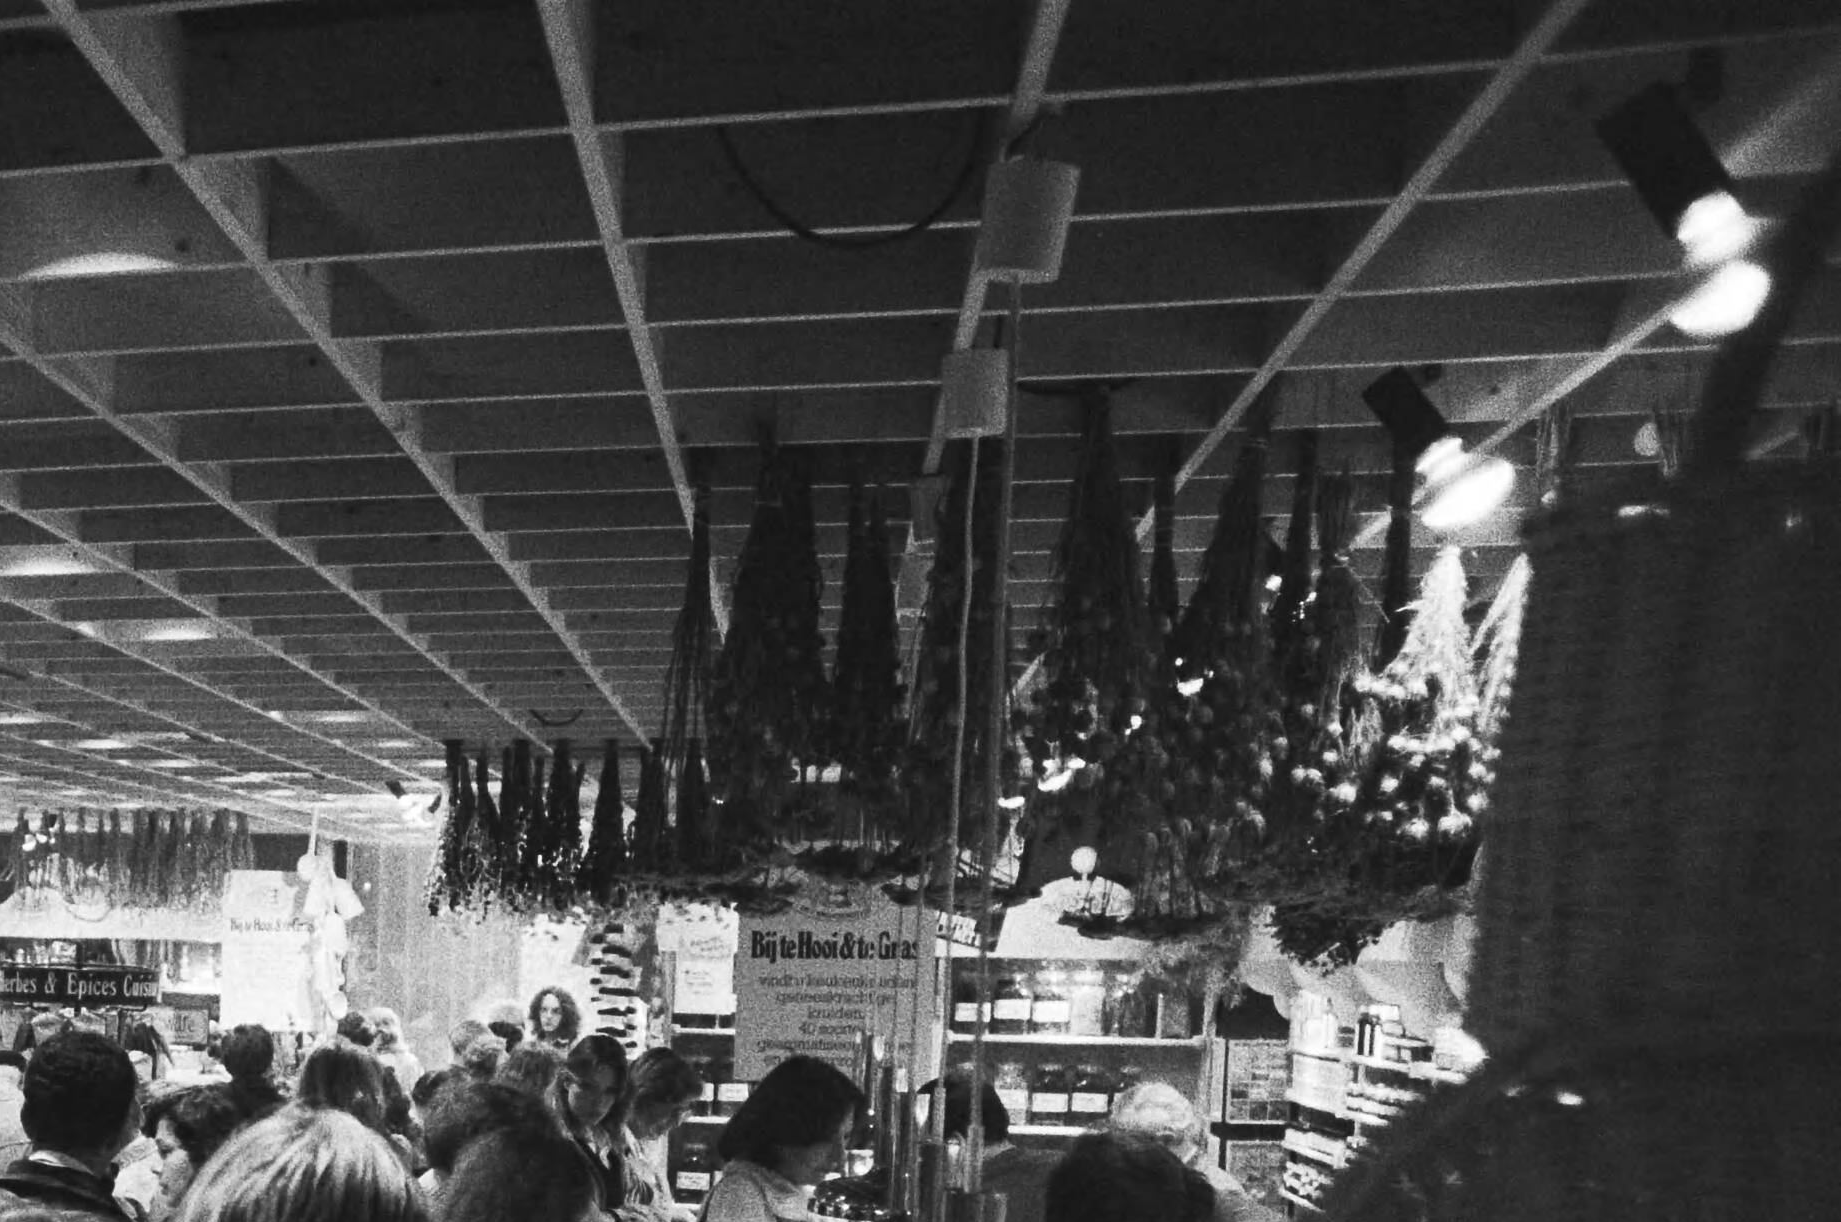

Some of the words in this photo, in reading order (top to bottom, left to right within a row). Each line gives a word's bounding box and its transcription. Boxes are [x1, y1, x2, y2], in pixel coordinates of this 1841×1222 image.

[751, 930, 777, 964] Bij
[780, 935, 796, 959] te
[798, 930, 838, 959] Hooi
[839, 931, 857, 959] &
[44, 971, 56, 994] &
[67, 972, 117, 1000] Epices
